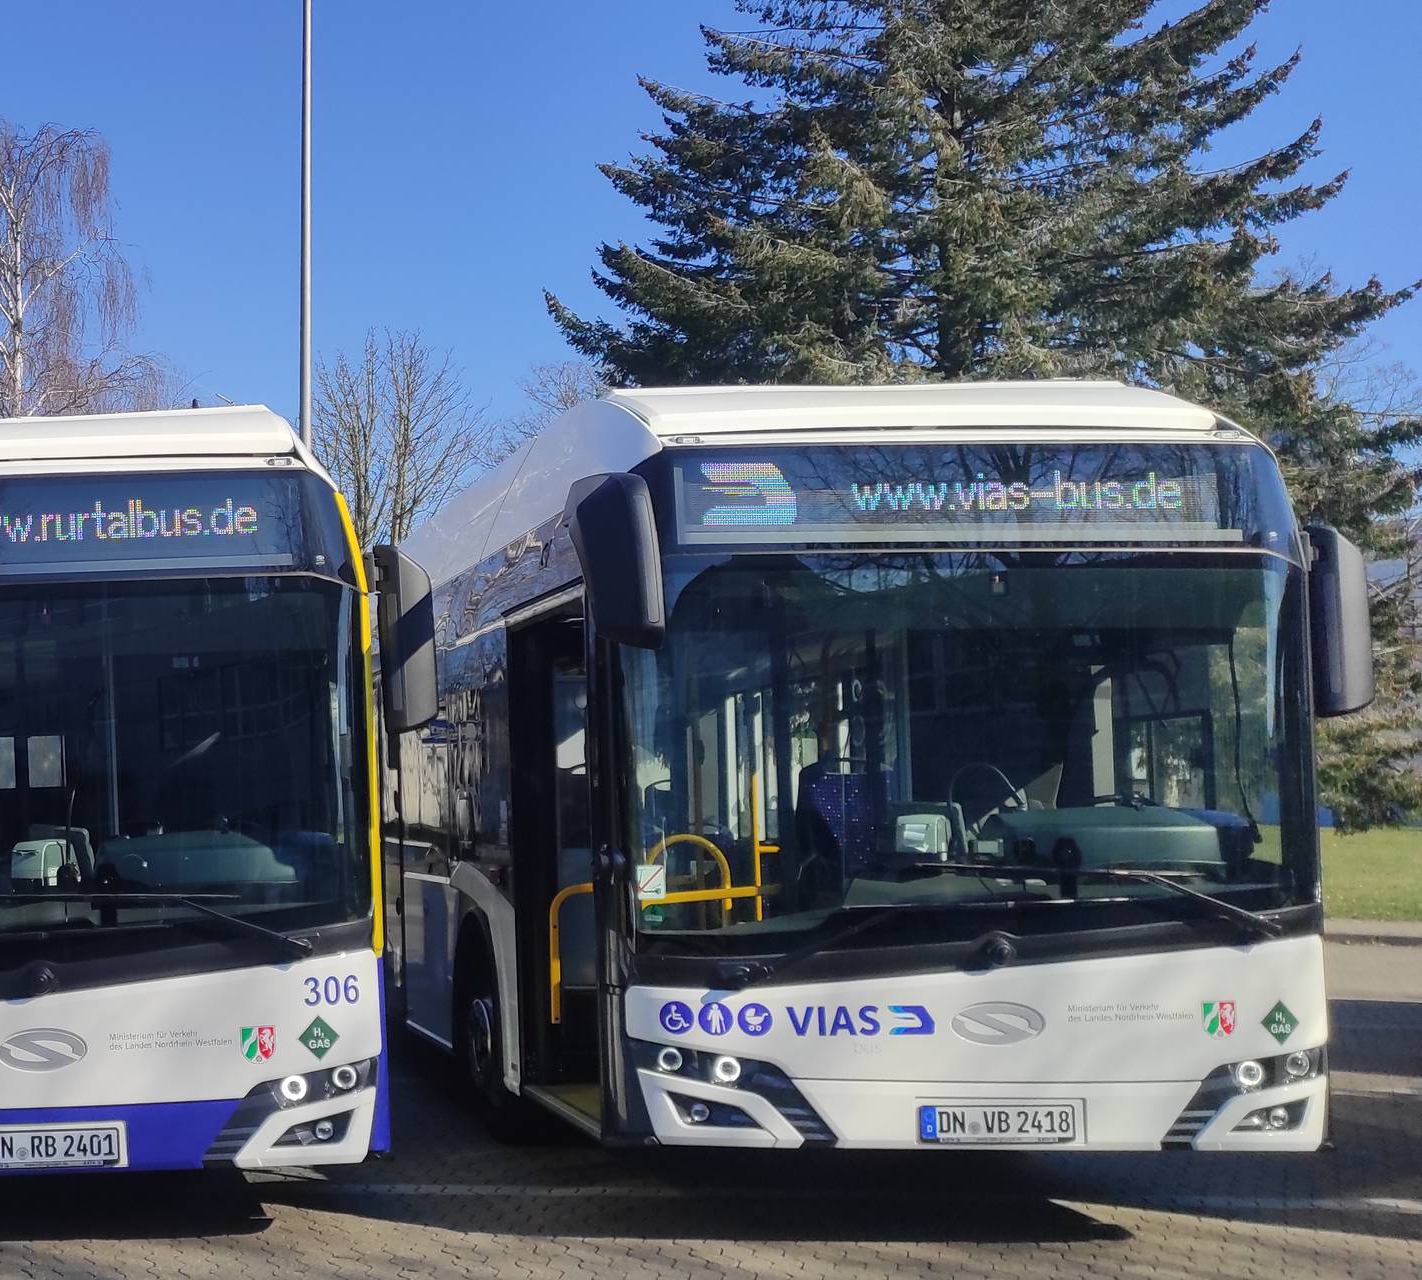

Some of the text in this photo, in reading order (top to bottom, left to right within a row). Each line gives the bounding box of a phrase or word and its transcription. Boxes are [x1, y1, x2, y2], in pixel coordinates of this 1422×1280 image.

[851, 471, 1182, 511] www.vias-bus.de
[303, 974, 361, 1008] 306
[1067, 1002, 1159, 1013] Ministerium für Verkehr
[785, 1005, 880, 1037] VIAS
[1067, 1014, 1082, 1023] des
[1084, 1013, 1113, 1023] Landes
[1270, 1023, 1292, 1034] GAS
[109, 1029, 198, 1041] Ministerium für Verkehr
[109, 1042, 123, 1051] des
[125, 1041, 153, 1050] Landes
[308, 1039, 331, 1050] GAS
[938, 1110, 1070, 1134] DN VB 2418
[926, 1124, 933, 1133] D
[31, 1135, 57, 1158] RB
[63, 1133, 115, 1158] 2401
